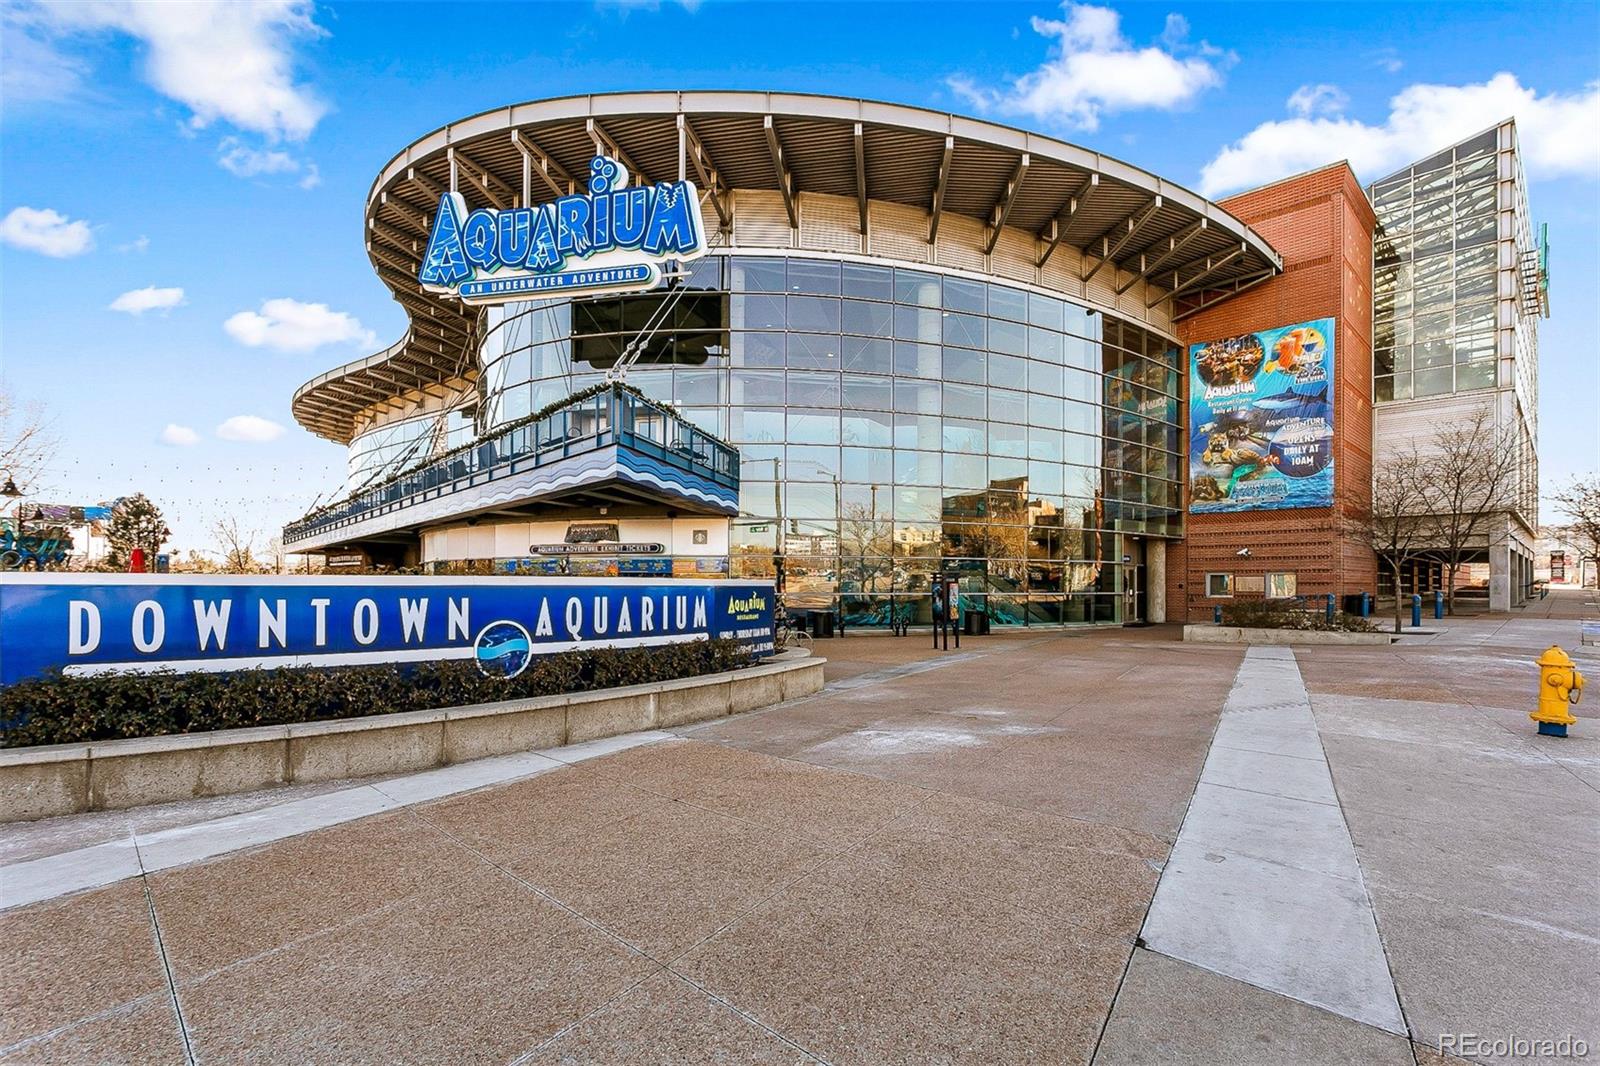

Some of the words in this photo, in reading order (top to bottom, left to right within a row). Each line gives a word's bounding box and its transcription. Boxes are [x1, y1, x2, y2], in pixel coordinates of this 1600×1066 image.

[420, 156, 697, 284] AQUARIUM
[469, 284, 483, 294] AN
[491, 278, 563, 292] UNDERWATER
[572, 270, 639, 283] ADVENTURE
[1282, 416, 1326, 431] ADVENTURE
[1288, 433, 1315, 444] OPENS
[1283, 446, 1307, 456] DAILY
[1309, 443, 1320, 454] AT
[1291, 455, 1314, 466] 10AM
[538, 545, 564, 554] AQUARIUM
[566, 545, 598, 553] ADVENTURE
[626, 544, 651, 552] TICKETS
[728, 591, 766, 614] AQUARIUM
[68, 597, 470, 655] DOWNTOWN
[535, 595, 707, 641] AQUARIUM
